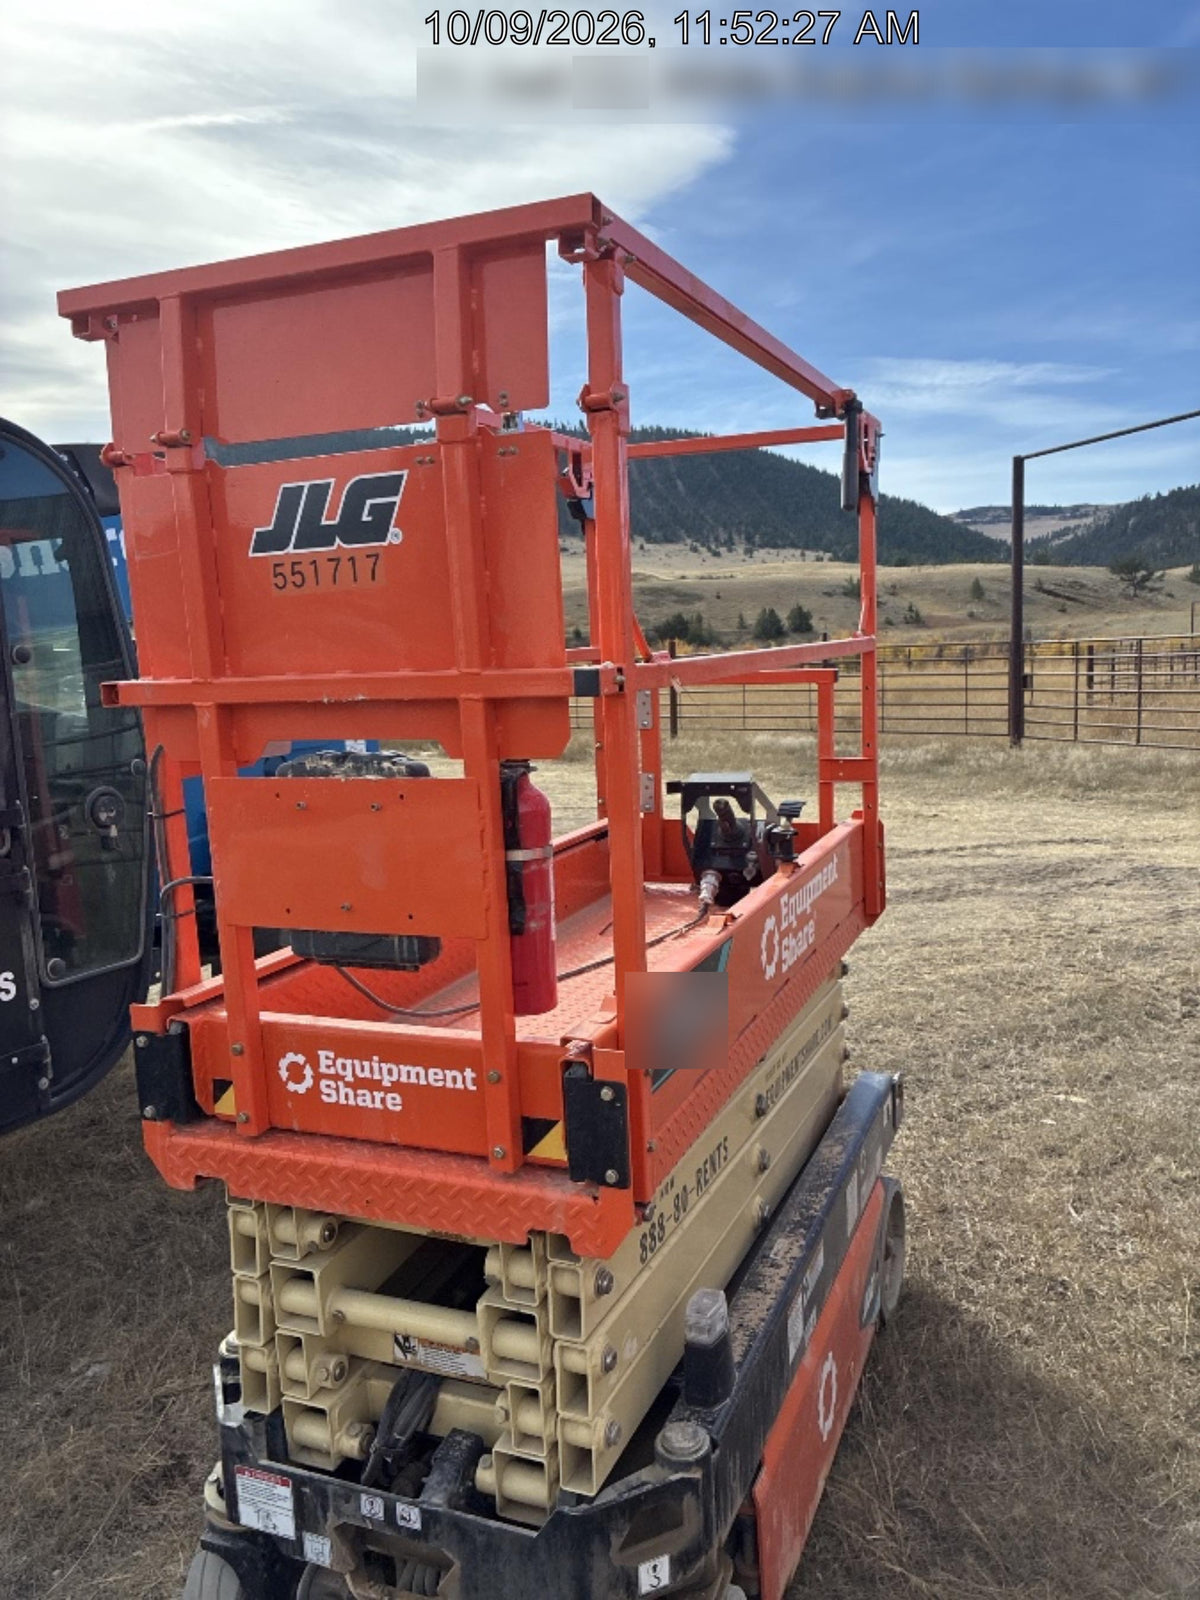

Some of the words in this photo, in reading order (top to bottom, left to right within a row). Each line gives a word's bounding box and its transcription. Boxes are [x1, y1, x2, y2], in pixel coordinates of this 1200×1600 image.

[249, 469, 409, 558] JLG
[272, 552, 380, 591] 551717
[780, 853, 838, 932] Equipment
[781, 919, 816, 974] Share
[317, 1049, 478, 1091] Equipment
[319, 1078, 403, 1112] Share
